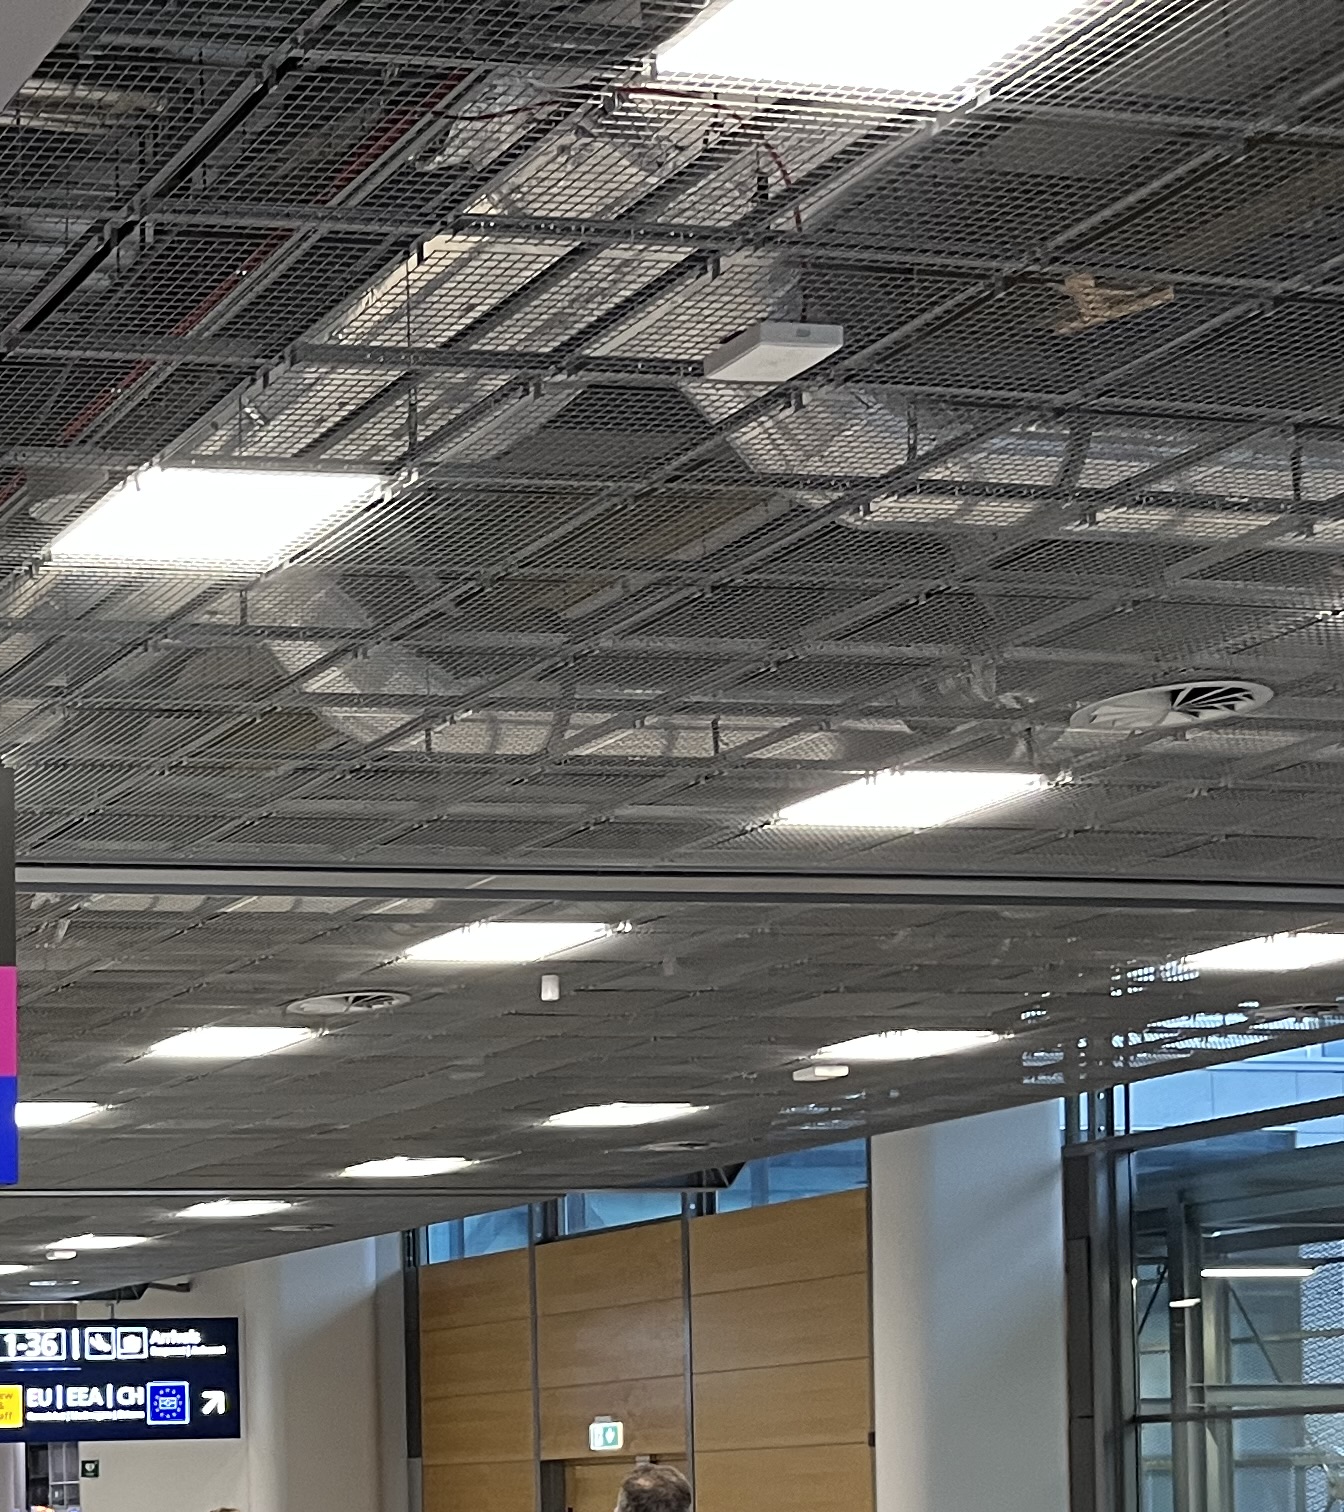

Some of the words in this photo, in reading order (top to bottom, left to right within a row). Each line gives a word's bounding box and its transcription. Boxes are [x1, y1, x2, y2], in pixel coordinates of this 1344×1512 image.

[3, 1332, 59, 1357] 1-36
[26, 1387, 53, 1408] EU
[66, 1386, 105, 1407] EEA
[116, 1386, 145, 1406] CH
